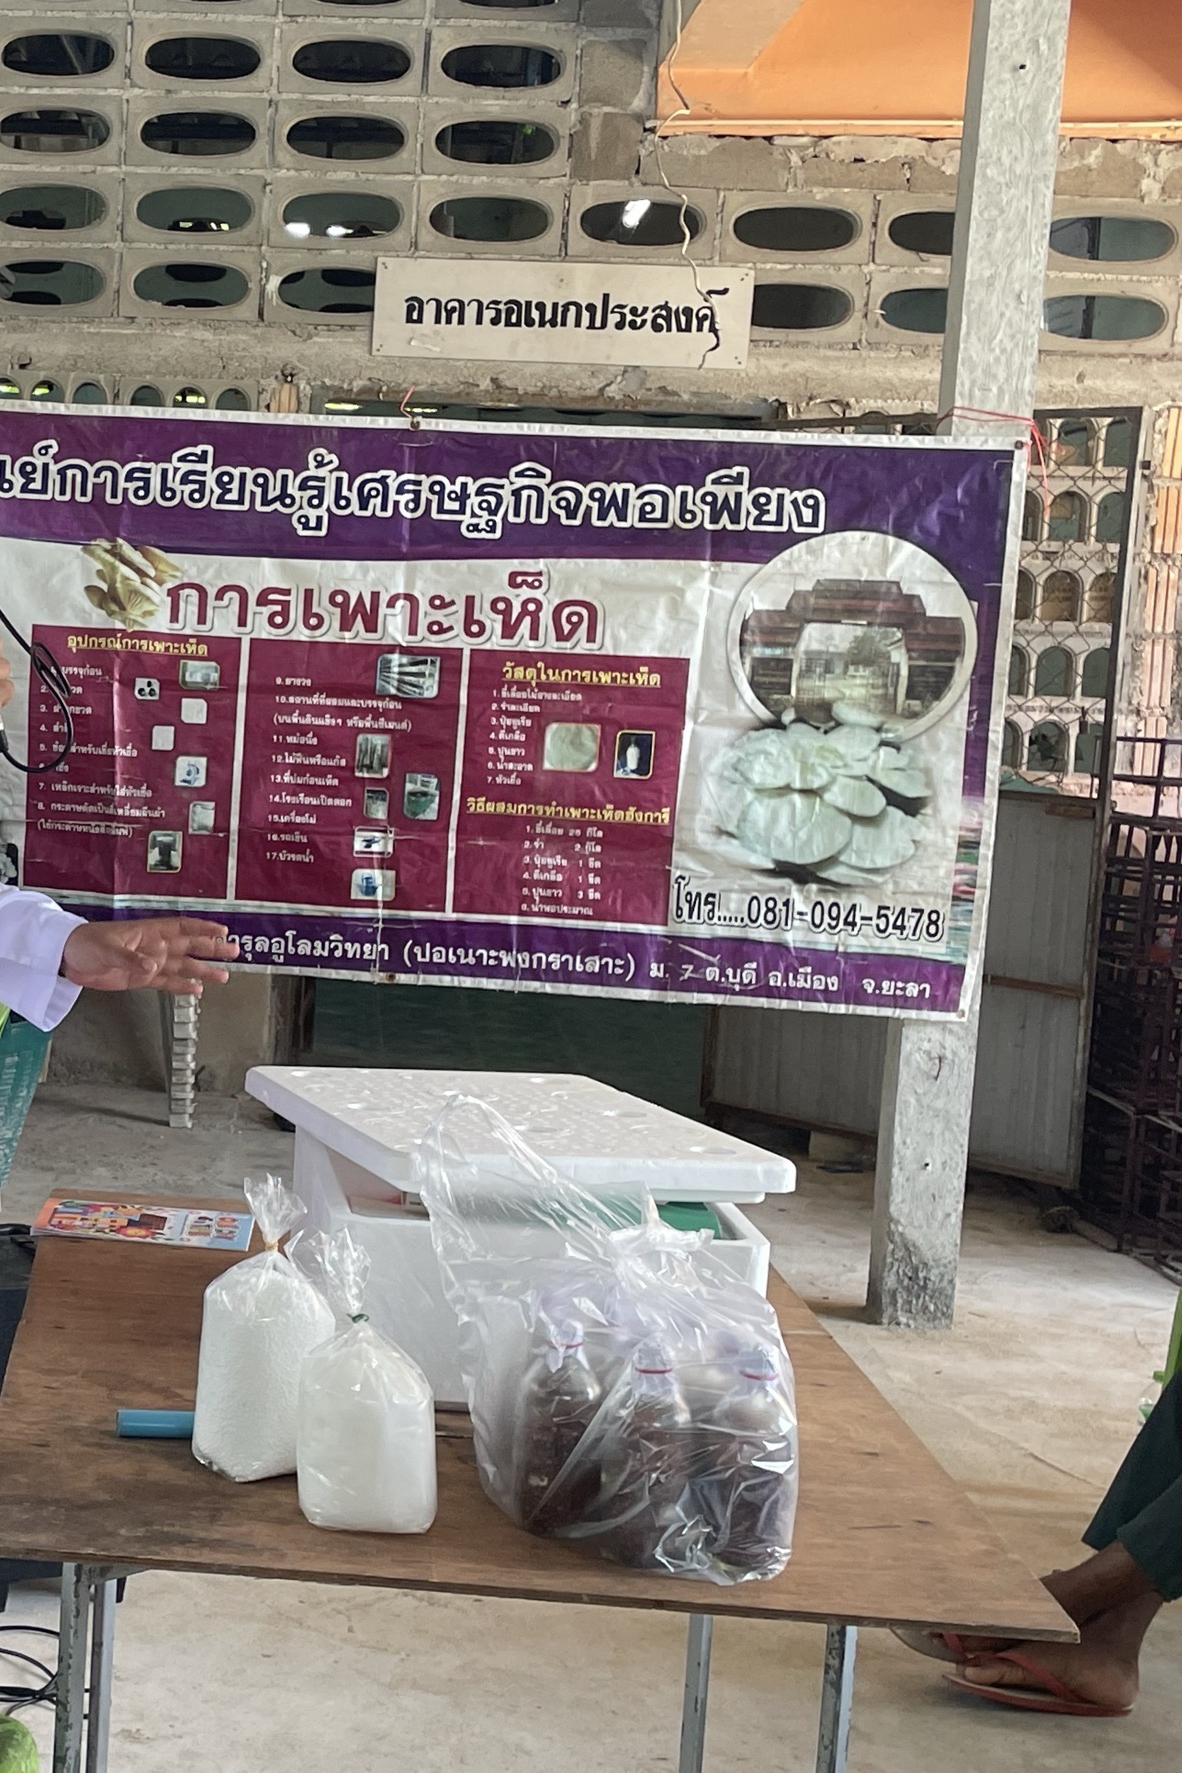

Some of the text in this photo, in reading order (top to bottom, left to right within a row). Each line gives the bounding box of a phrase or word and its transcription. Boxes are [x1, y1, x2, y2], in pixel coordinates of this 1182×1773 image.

[404, 287, 729, 333] อาคารอเนกประสงค์
[167, 570, 603, 646] การเพาะเห็ด
[67, 634, 208, 656] อุปกรณ์การเพาะเห็ด
[502, 661, 661, 687] วัสดุในการเพาะเห็ด
[403, 939, 636, 982] (ปอเนาะพงกราเสาะ)
[768, 966, 839, 991] อ.เมือง
[862, 977, 931, 999] จ.ยะลา
